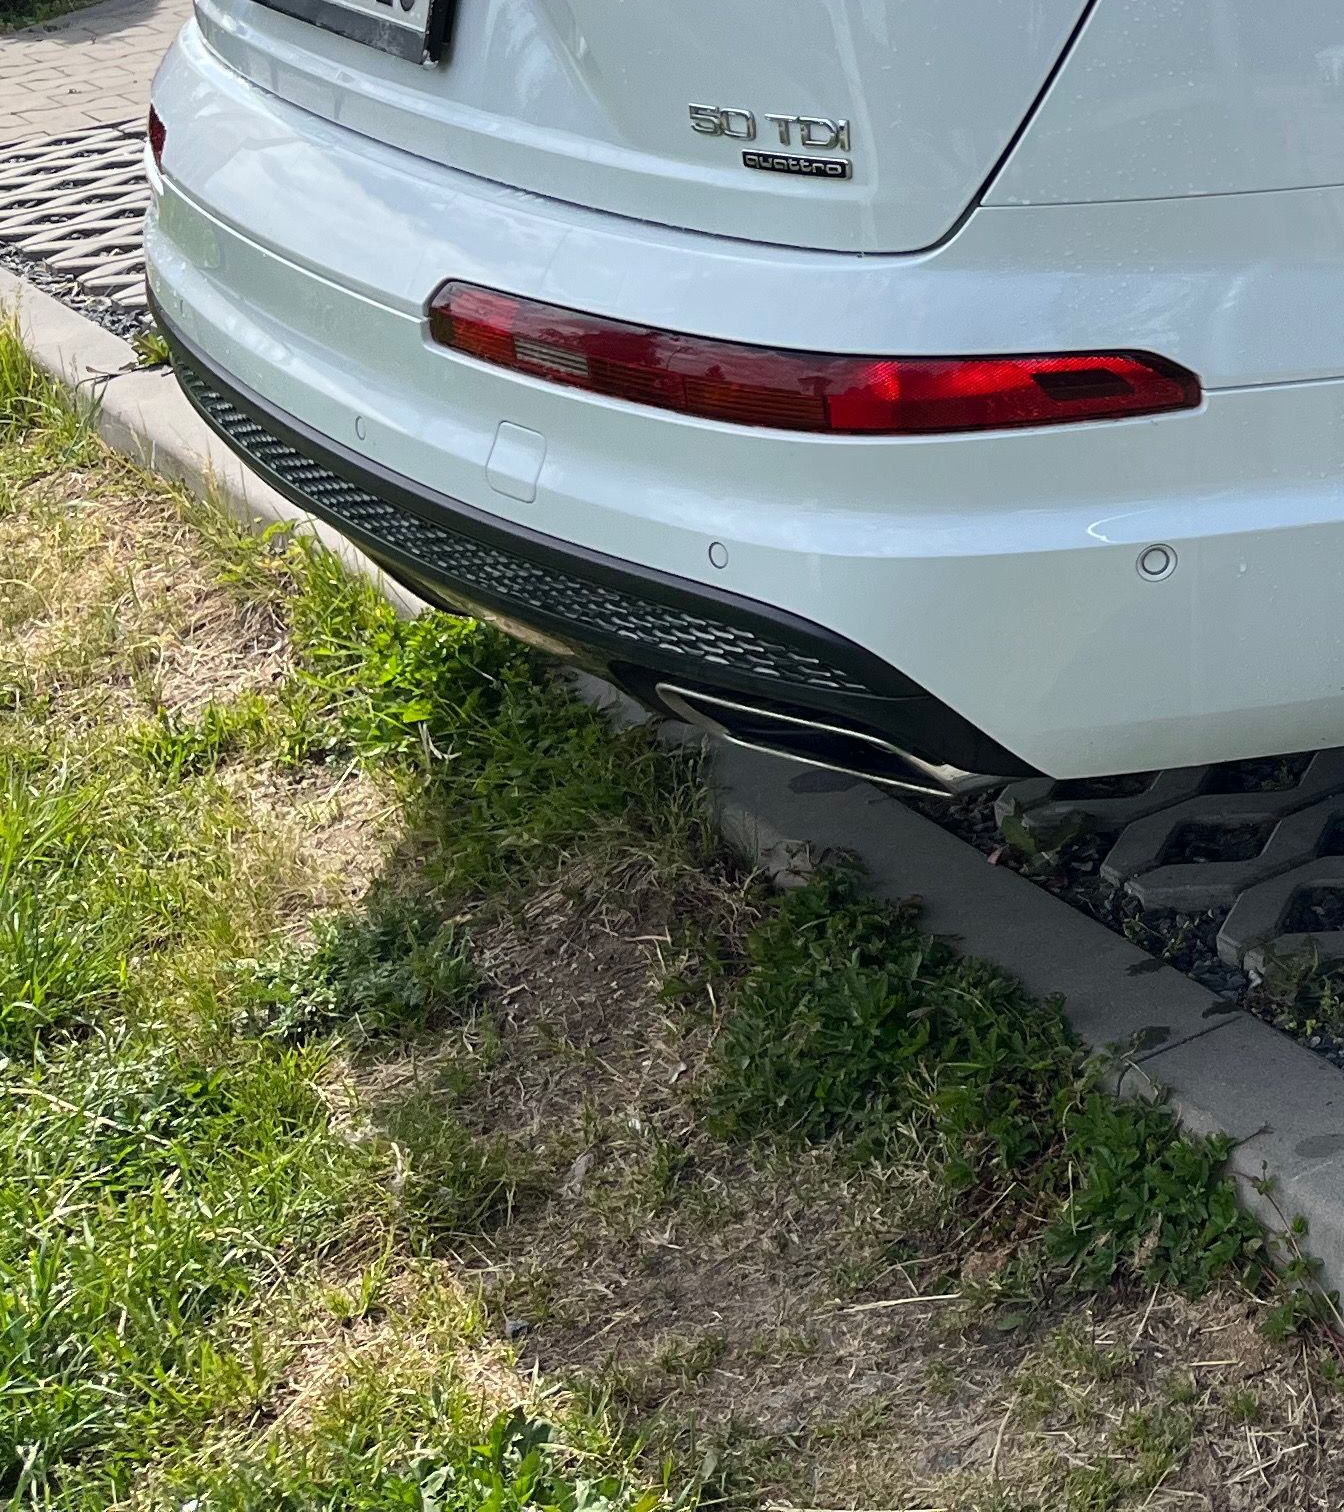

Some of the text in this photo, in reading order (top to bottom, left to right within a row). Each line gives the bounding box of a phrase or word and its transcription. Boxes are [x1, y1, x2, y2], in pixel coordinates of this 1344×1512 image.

[688, 102, 850, 152] 50 TDI
[744, 154, 843, 175] quattro
